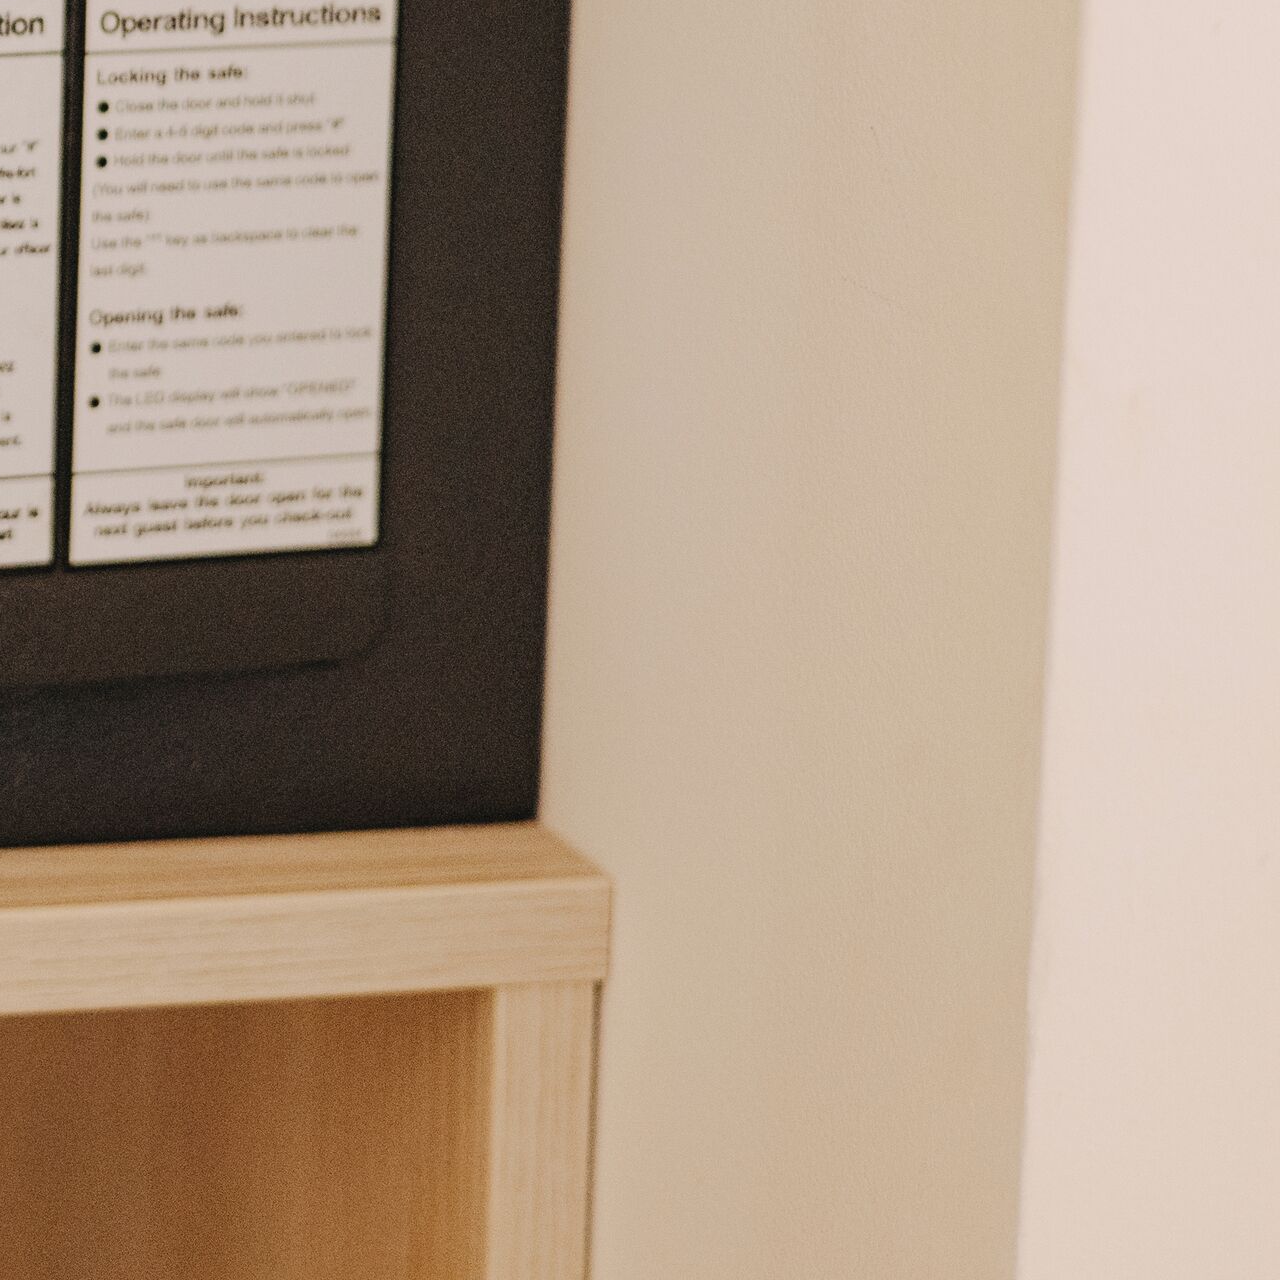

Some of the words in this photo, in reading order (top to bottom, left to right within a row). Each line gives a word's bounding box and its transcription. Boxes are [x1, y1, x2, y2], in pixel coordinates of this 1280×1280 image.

[99, 6, 226, 40] Operating
[233, 0, 381, 28] Instructions
[96, 65, 165, 88] Locking
[173, 63, 200, 81] the
[89, 305, 164, 328] Opening
[170, 303, 196, 319] the
